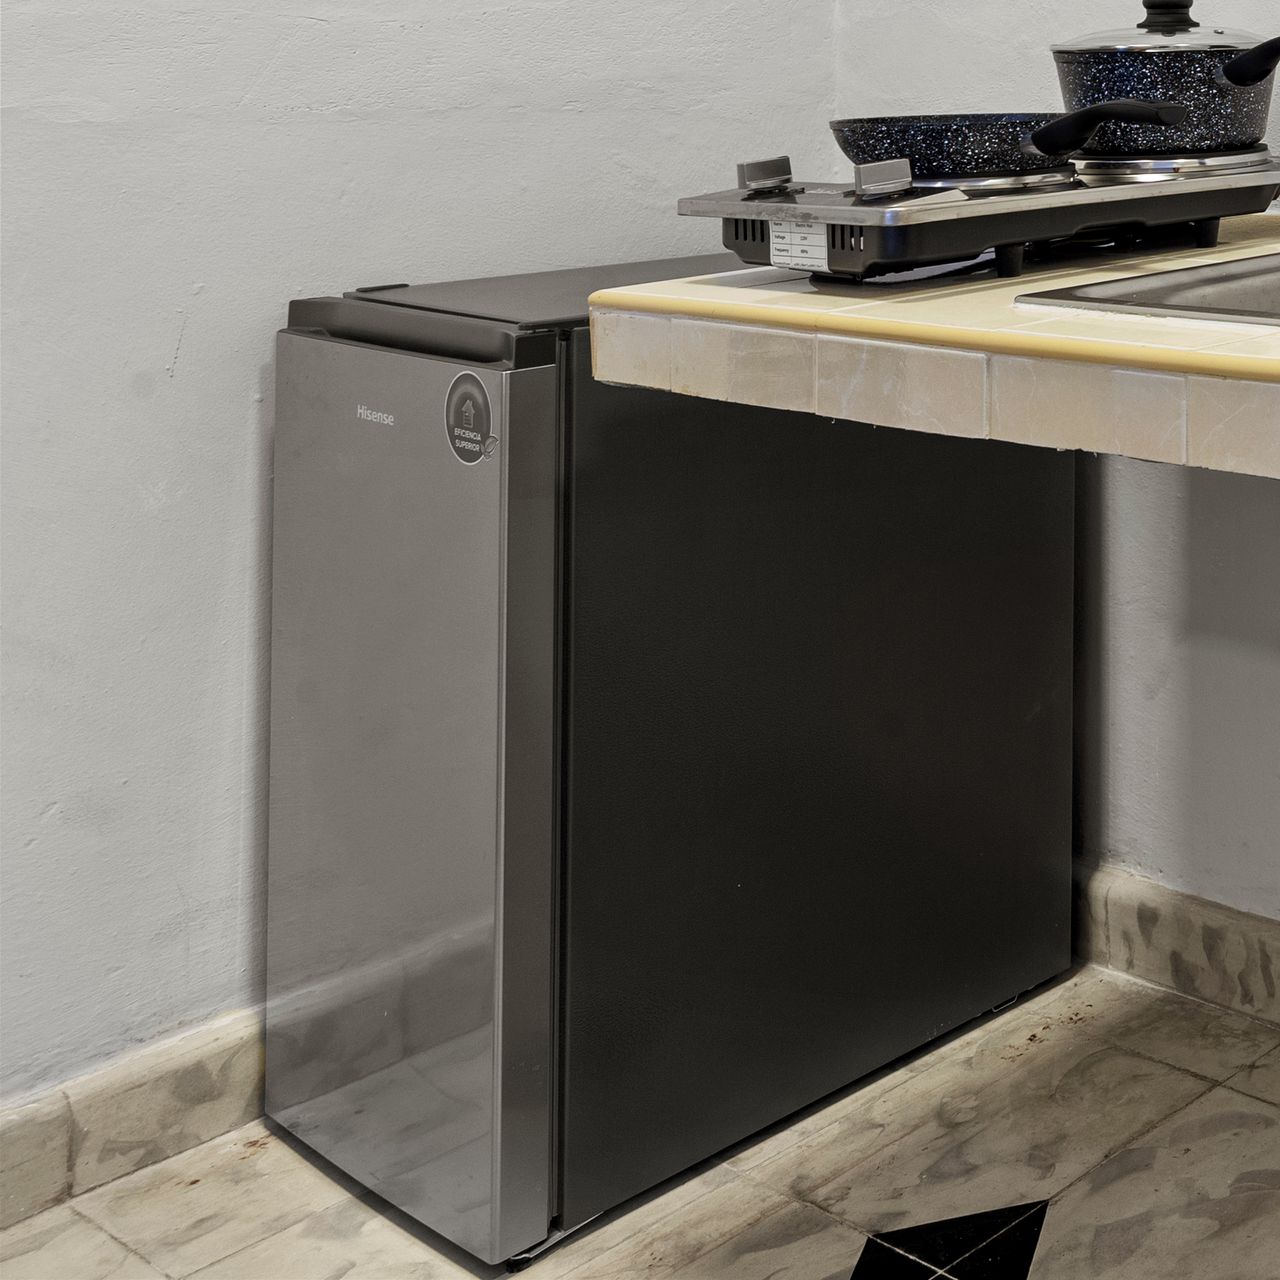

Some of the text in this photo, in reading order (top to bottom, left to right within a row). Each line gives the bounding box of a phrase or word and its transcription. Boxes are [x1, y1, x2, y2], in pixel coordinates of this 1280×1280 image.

[357, 404, 395, 426] Hisense
[454, 427, 482, 441] EFICIENCIA
[455, 439, 480, 452] SUPERIOR
